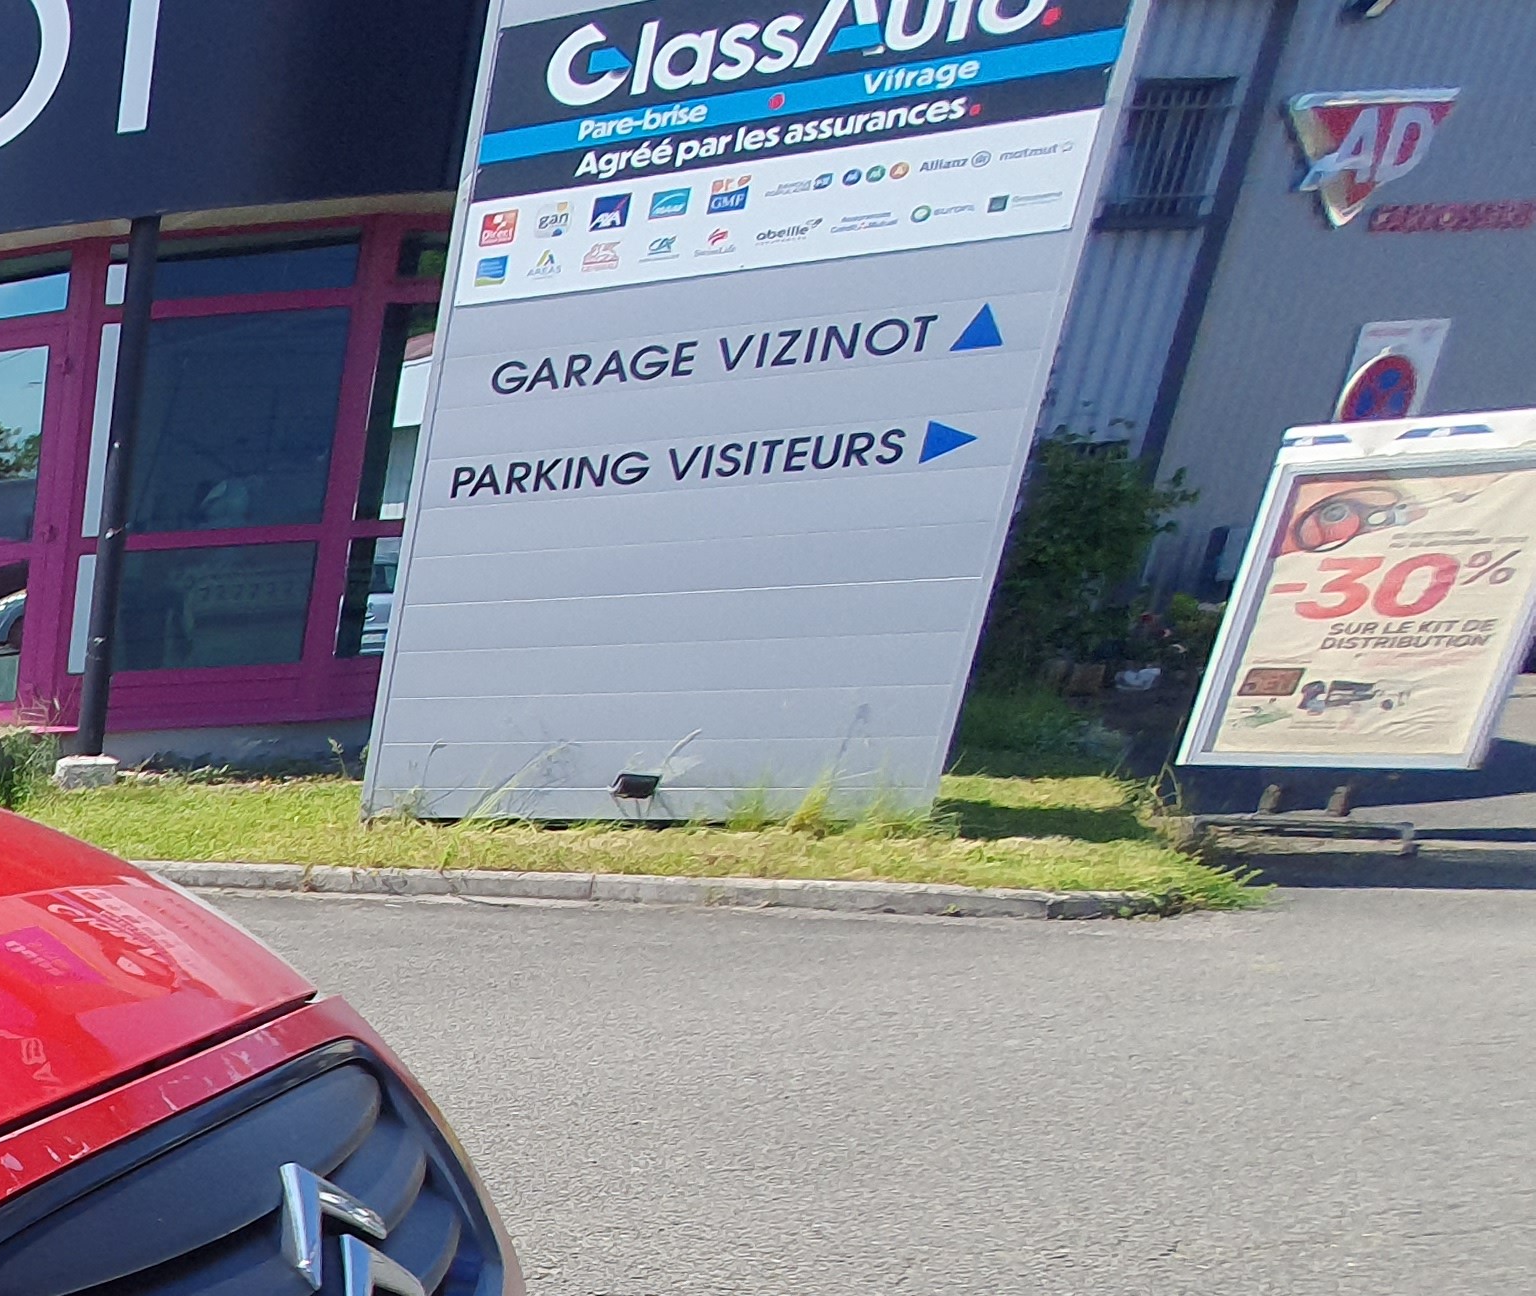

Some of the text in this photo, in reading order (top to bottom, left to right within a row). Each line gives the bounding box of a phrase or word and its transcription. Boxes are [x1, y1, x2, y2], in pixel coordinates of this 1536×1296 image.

[577, 59, 981, 142] Pare-brise Vitrage
[574, 137, 674, 180] Agréé
[674, 132, 734, 168] par
[733, 124, 780, 154] les
[919, 157, 970, 173] Allianz
[1302, 106, 1435, 188] AD
[710, 192, 745, 210] GMF
[537, 211, 570, 230] gan
[756, 224, 810, 241] abeille
[490, 313, 939, 395] GARAGE VIZINOT
[450, 427, 907, 500] PARKING VISITEURS
[1270, 549, 1522, 620] -30%
[1319, 633, 1496, 650] DISTRIBUTION
[1328, 618, 1499, 636] SUR LE KIT DE
